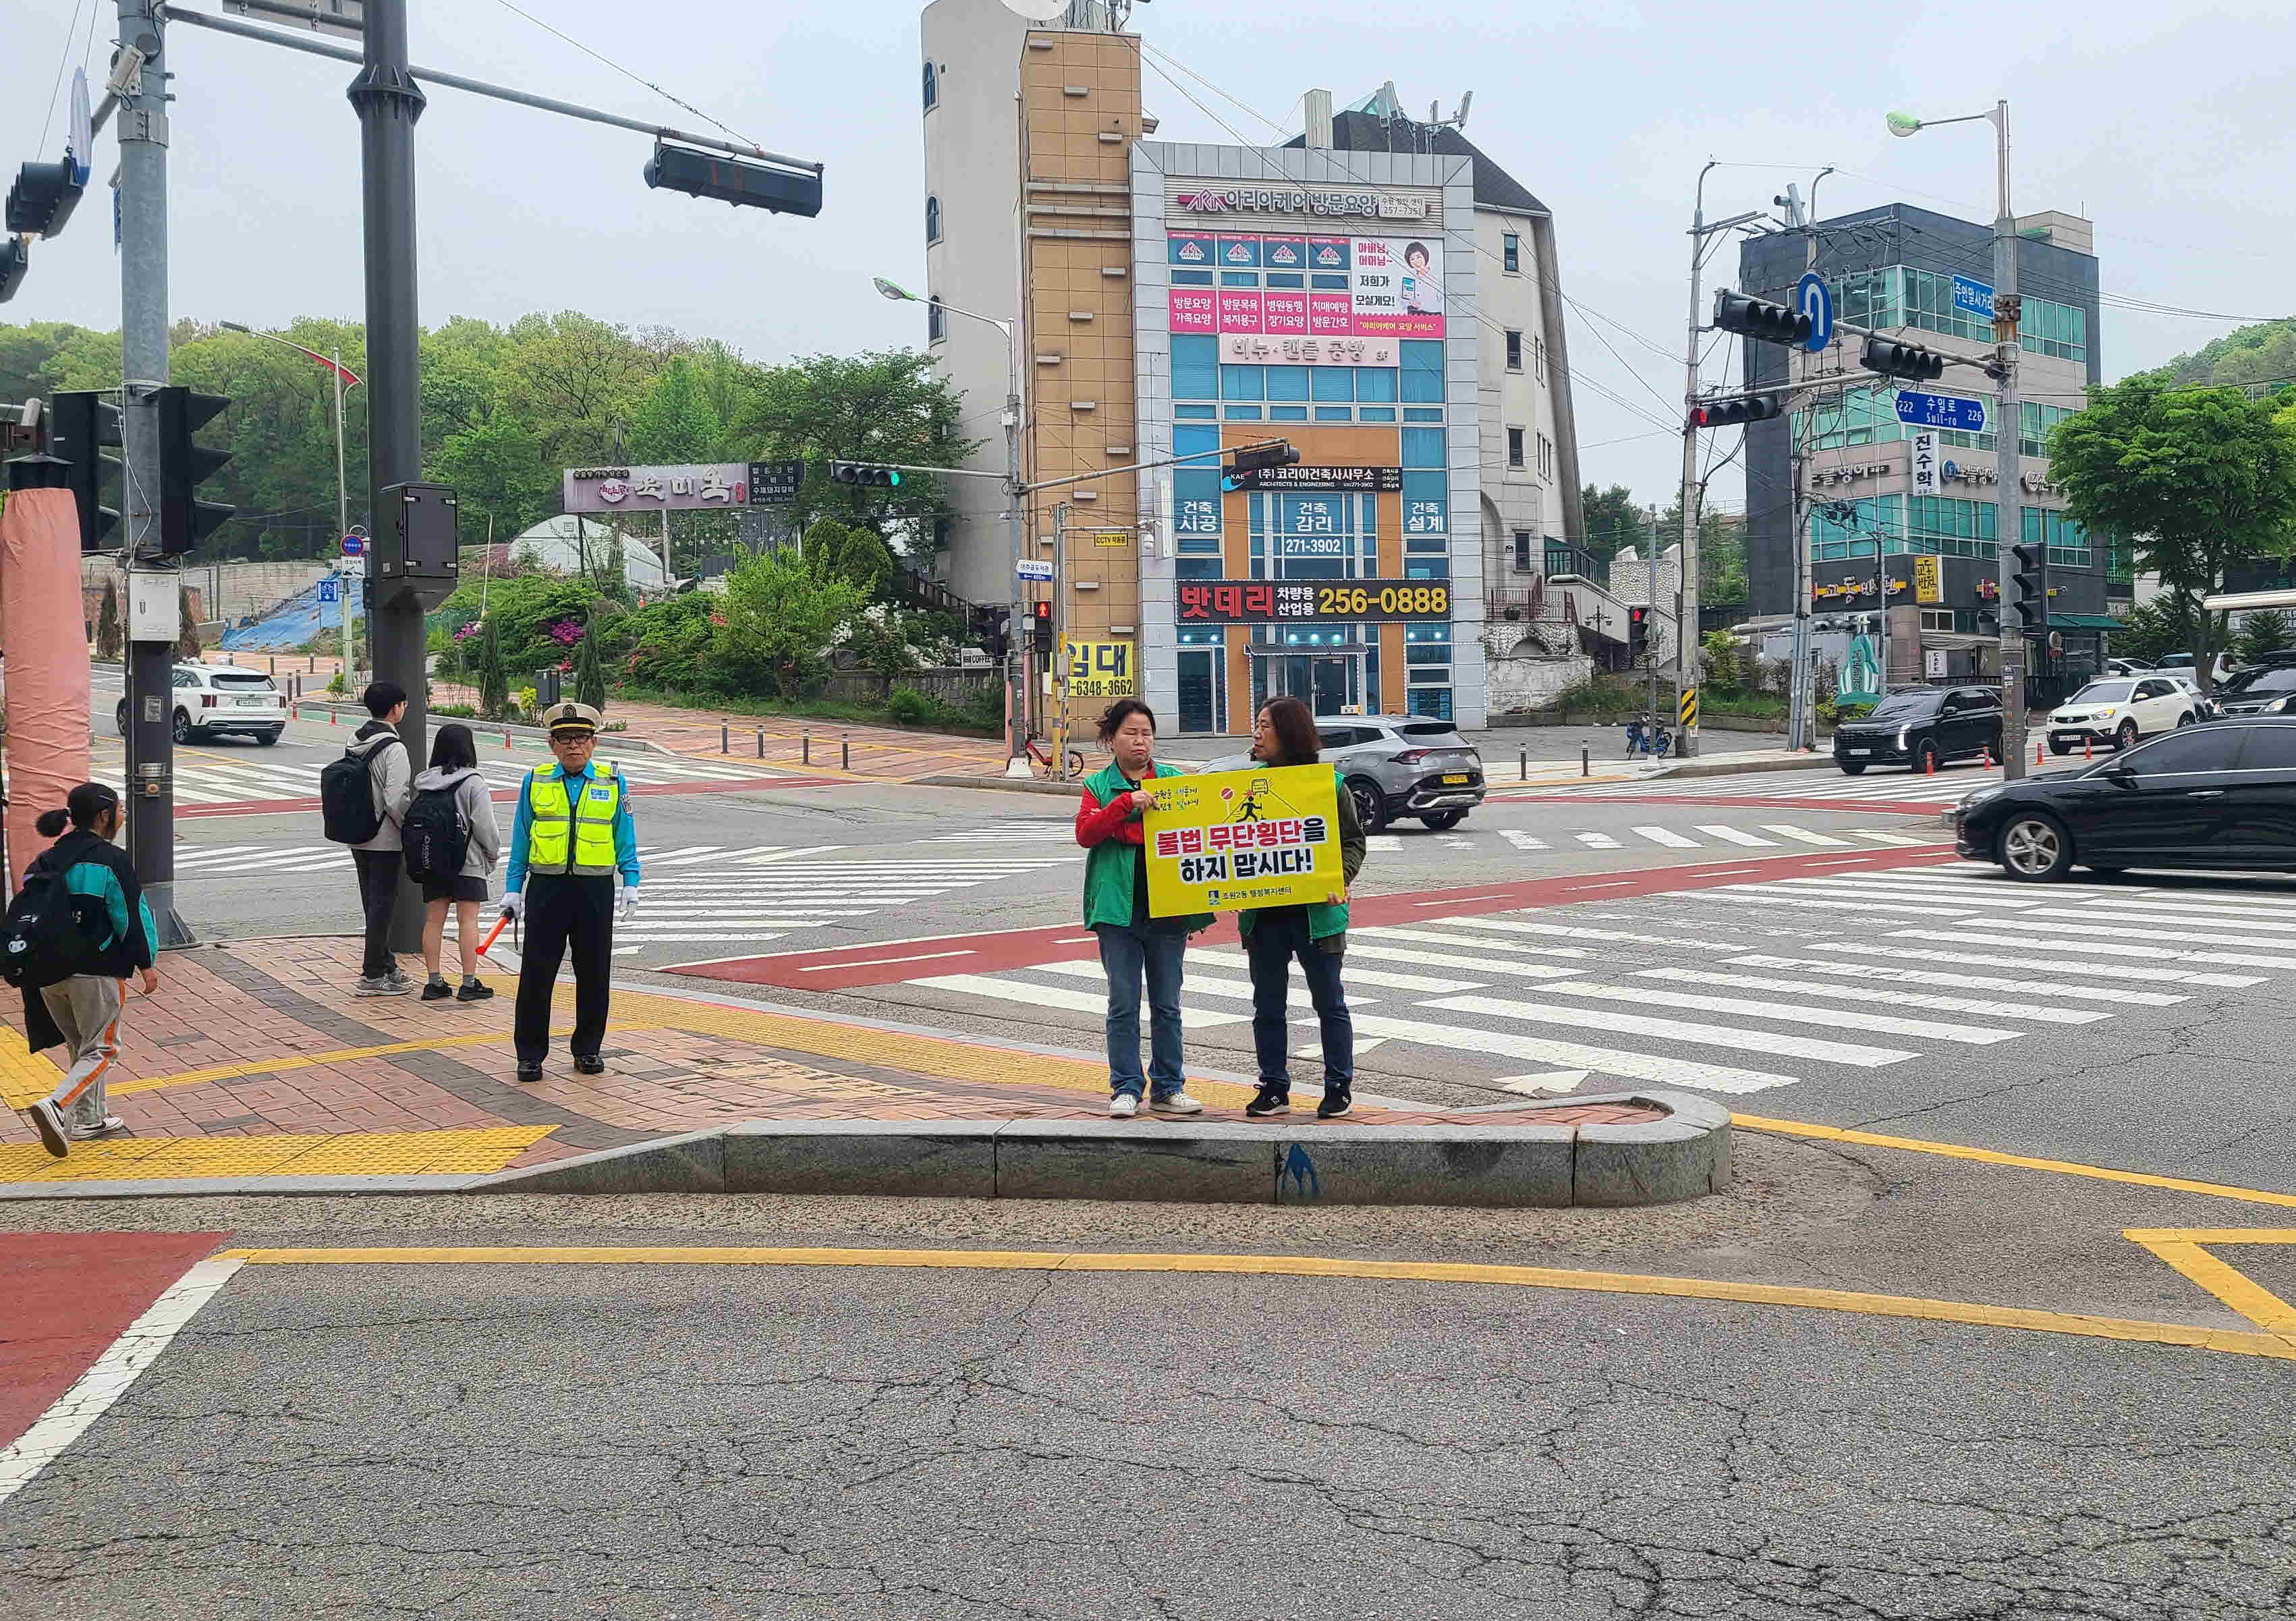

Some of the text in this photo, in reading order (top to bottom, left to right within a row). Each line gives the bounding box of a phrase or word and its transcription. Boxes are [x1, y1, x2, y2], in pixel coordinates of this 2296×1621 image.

[1360, 275, 1391, 287] 저희가
[1173, 296, 1212, 311] 방문요양
[1222, 298, 1258, 312] 방문목욕
[1266, 299, 1304, 313] 병원동행
[1311, 300, 1349, 314] 치매예방
[1355, 295, 1396, 307] 모실게요!
[1175, 312, 1212, 326] 가족요양
[1223, 314, 1258, 327] 복지용구
[1268, 314, 1304, 329] 장기요양
[1312, 316, 1349, 329] 방문간호
[1327, 339, 1366, 362] 공방
[1898, 395, 1982, 422] 222 수일로 226
[1926, 412, 1957, 426] Suil-ro
[1230, 473, 1246, 481] KAE
[1183, 501, 1213, 514] 건축
[1298, 501, 1328, 516] 건축
[1411, 502, 1439, 516] 건축
[1179, 515, 1217, 532] 시공
[1295, 516, 1333, 532] 감리
[1407, 515, 1444, 532] 설계
[1096, 536, 1111, 544] CCTV
[1285, 539, 1341, 553] 271-3902
[1276, 586, 1315, 601] 차량용
[1318, 587, 1448, 614] 256-0888
[1180, 585, 1274, 619] 밧데리
[1277, 602, 1315, 616] 산업용
[1157, 817, 1326, 856] 불법 무단횡단을
[1181, 848, 1313, 883] 하지 맙시다!
